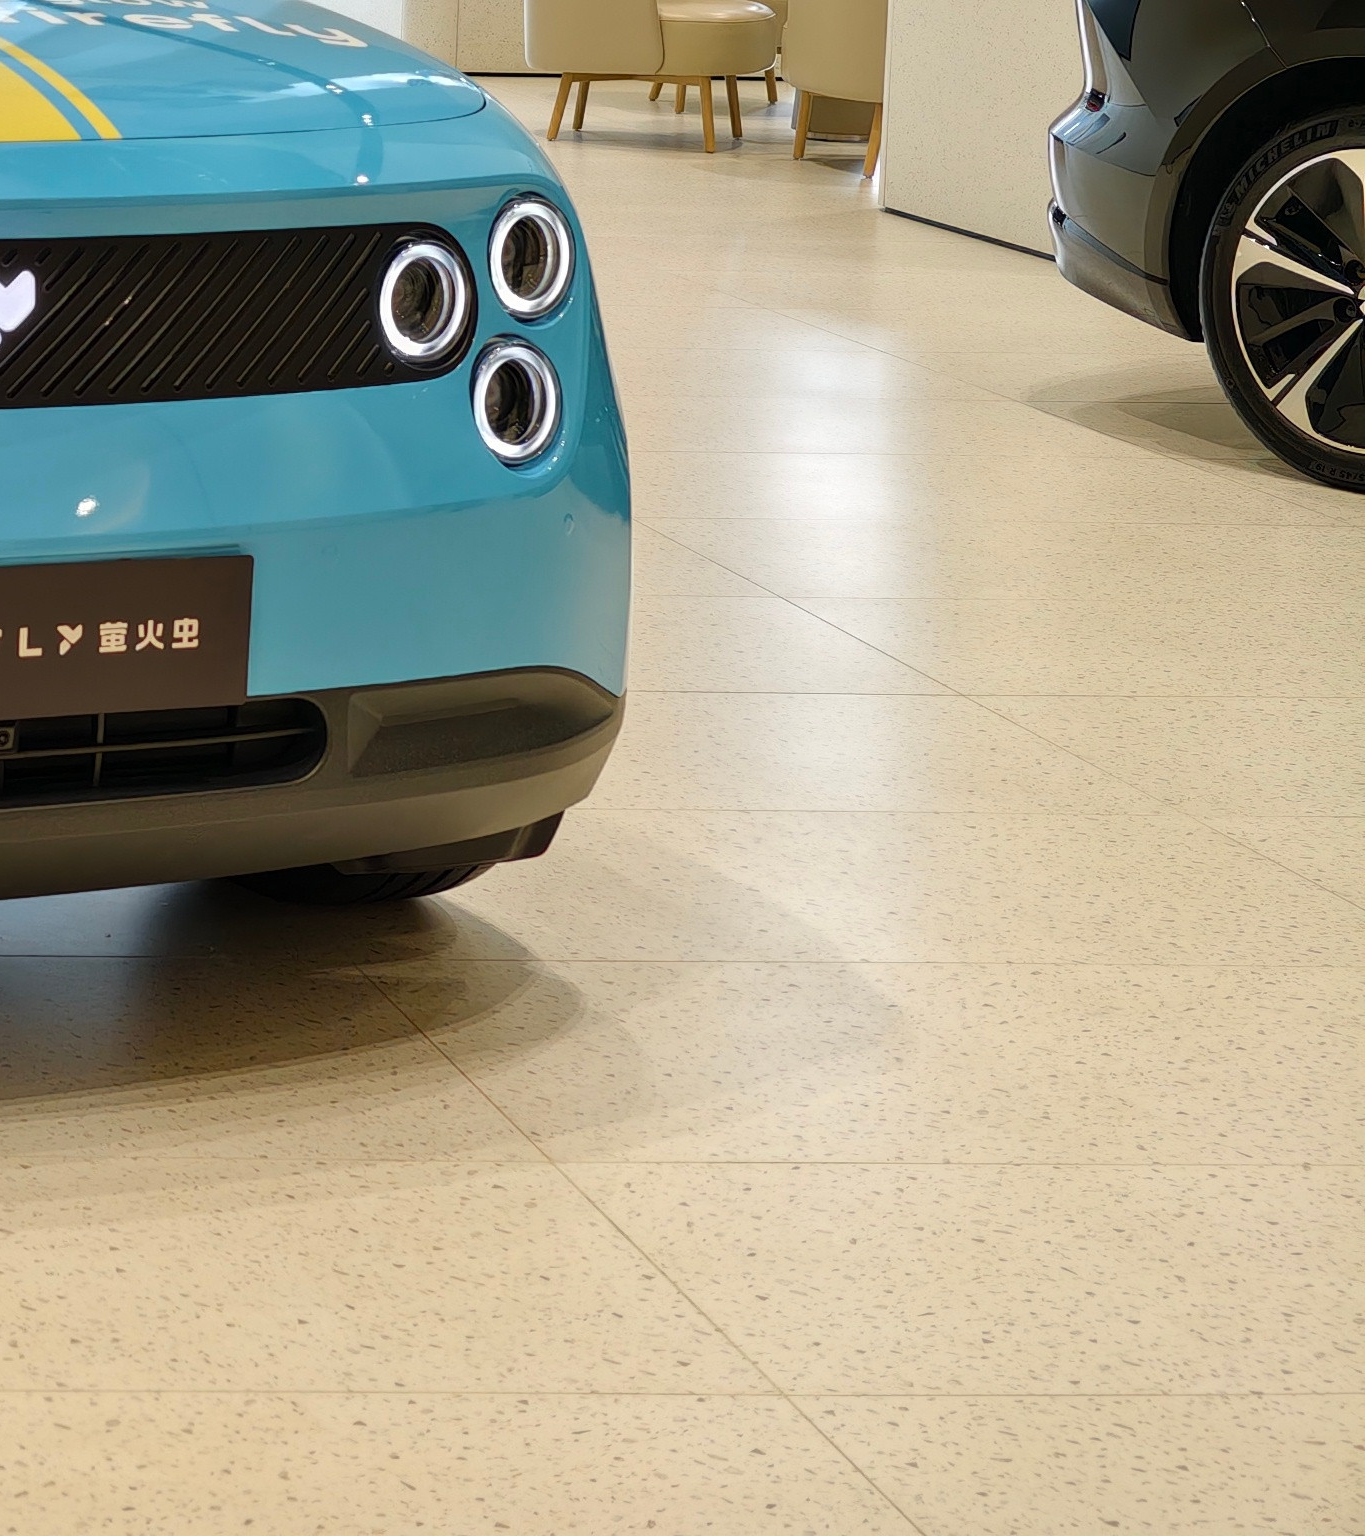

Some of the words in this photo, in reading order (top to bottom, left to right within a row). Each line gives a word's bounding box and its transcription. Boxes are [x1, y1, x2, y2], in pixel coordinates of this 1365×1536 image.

[1233, 121, 1332, 198] MICHELIN
[97, 616, 201, 655] 萤火虫
